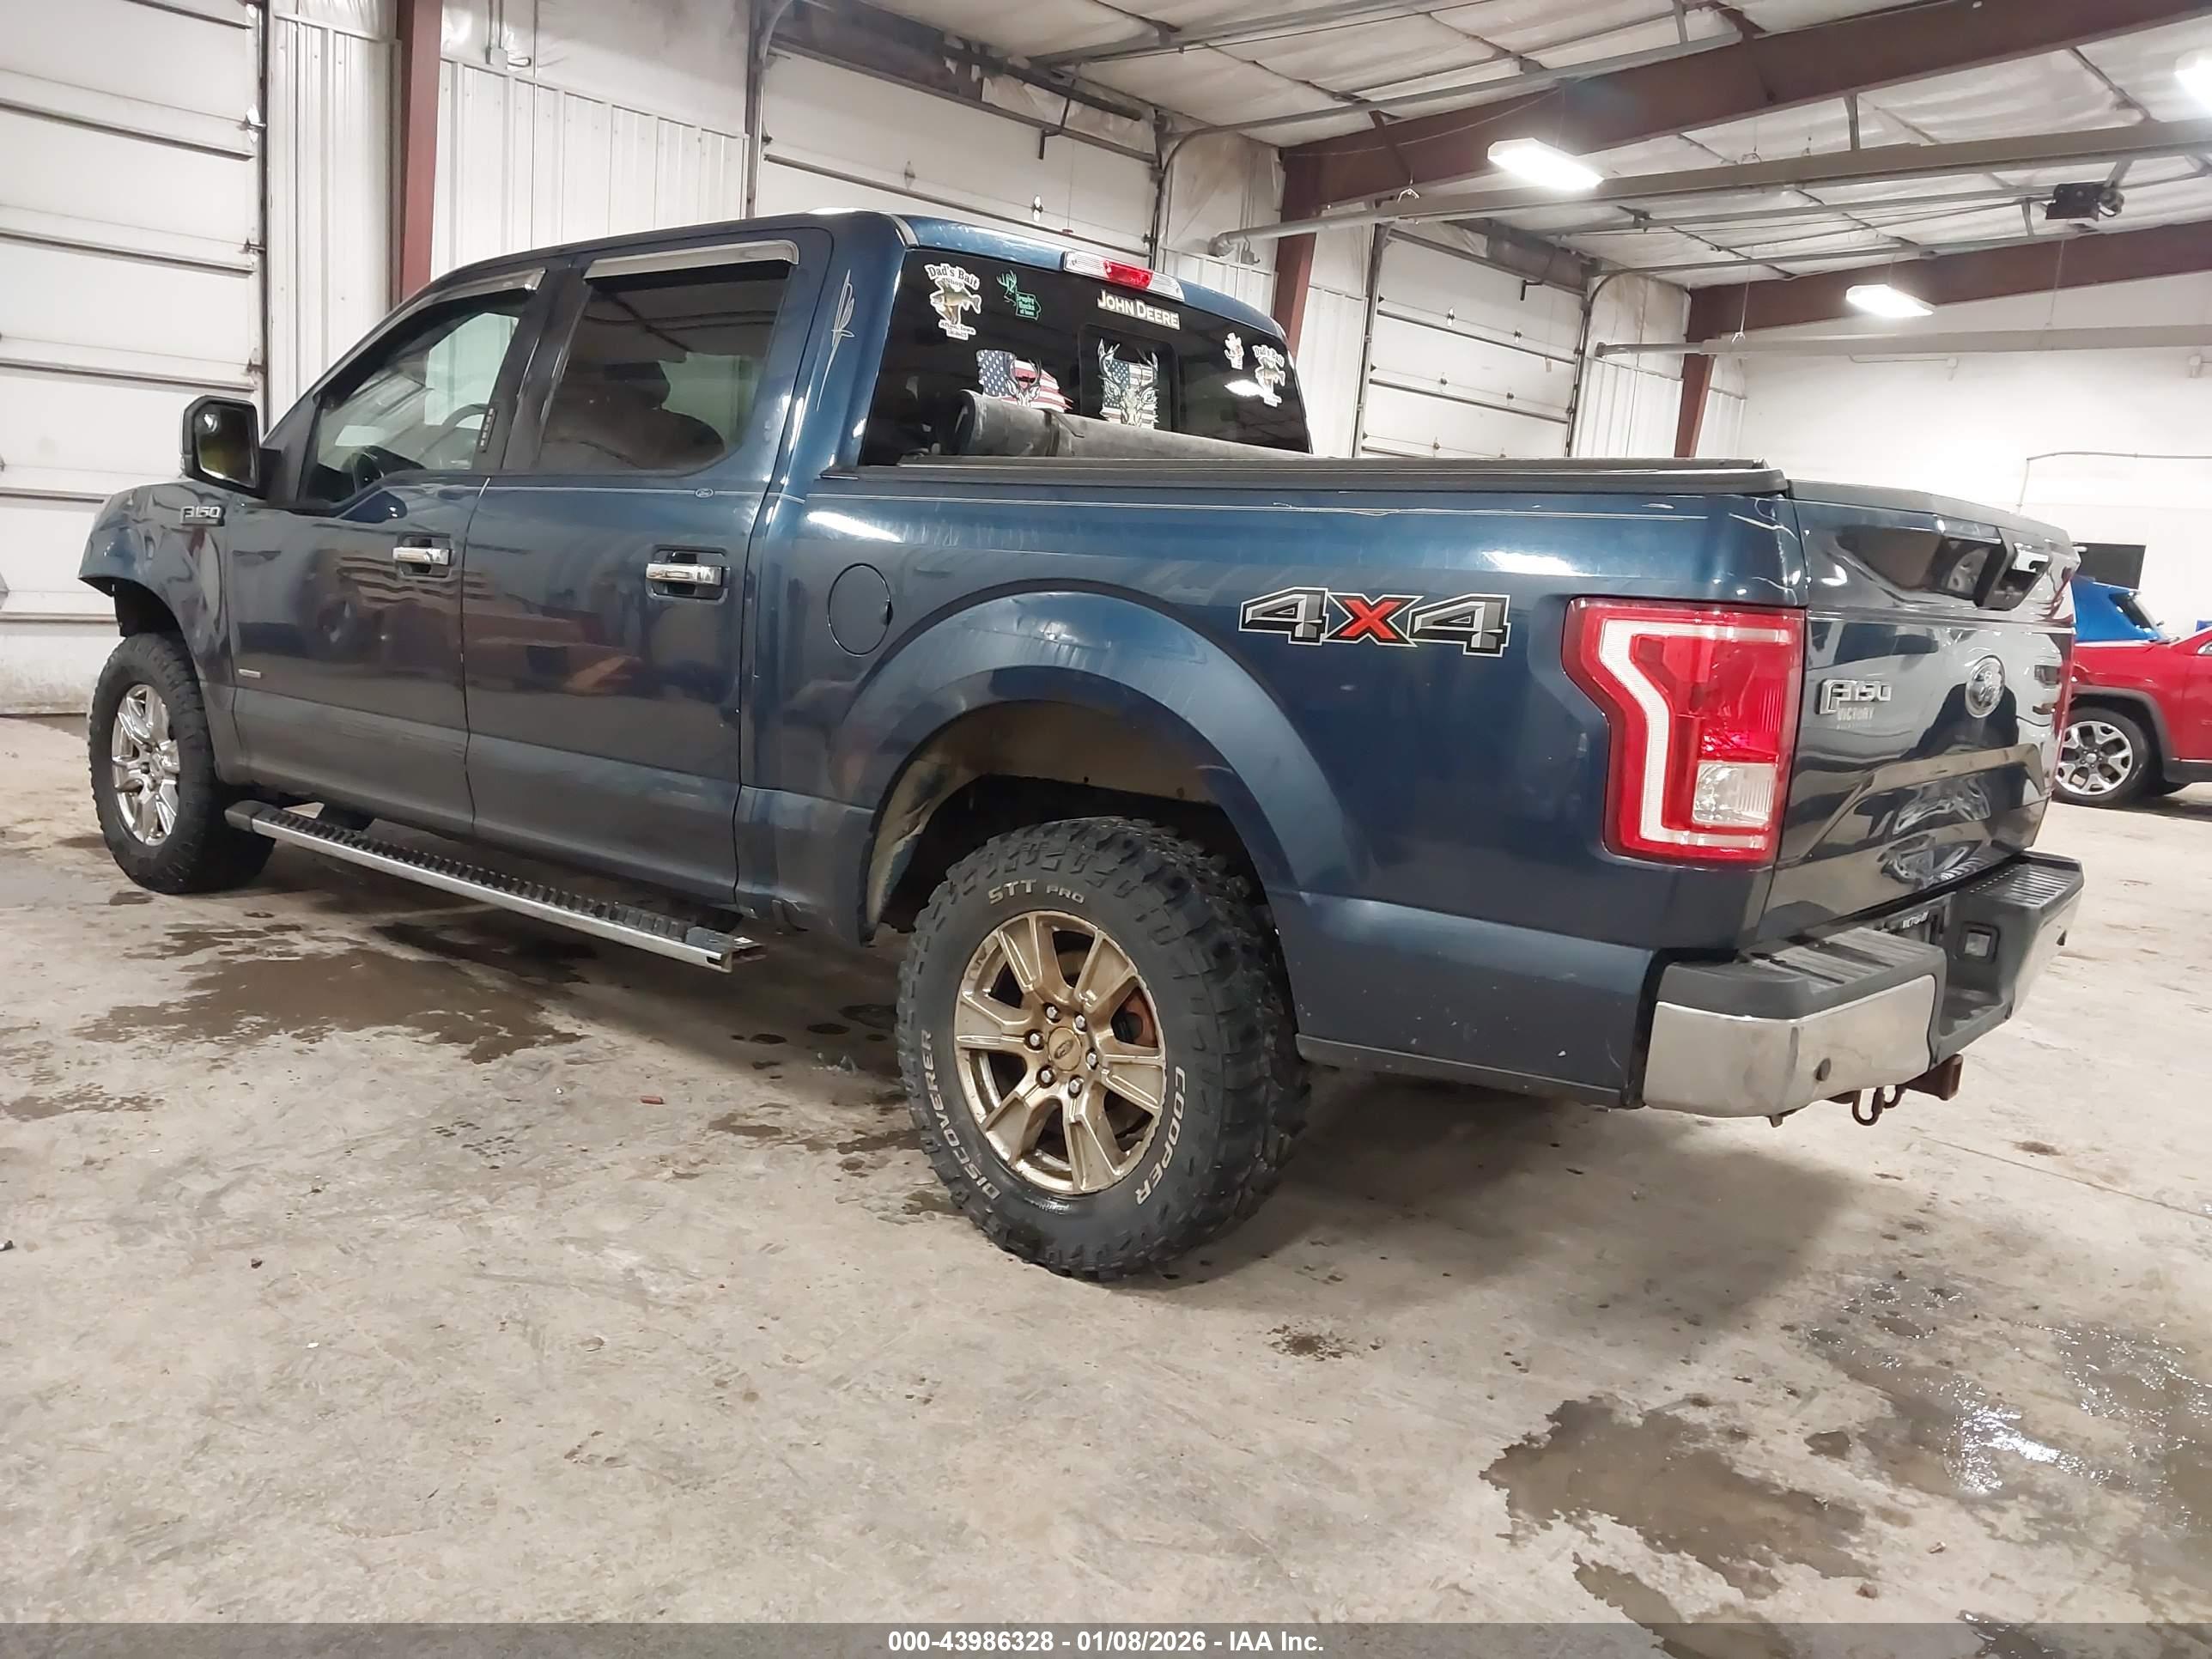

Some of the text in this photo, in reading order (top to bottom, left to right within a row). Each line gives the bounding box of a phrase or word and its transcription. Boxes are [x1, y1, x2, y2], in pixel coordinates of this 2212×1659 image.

[927, 264, 978, 289] Dad's Bait
[1097, 289, 1181, 331] JOHN DEERE
[988, 878, 1085, 904] STT PRO
[921, 1029, 1000, 1200] DISCOVERER
[1134, 1066, 1186, 1205] COOPER
